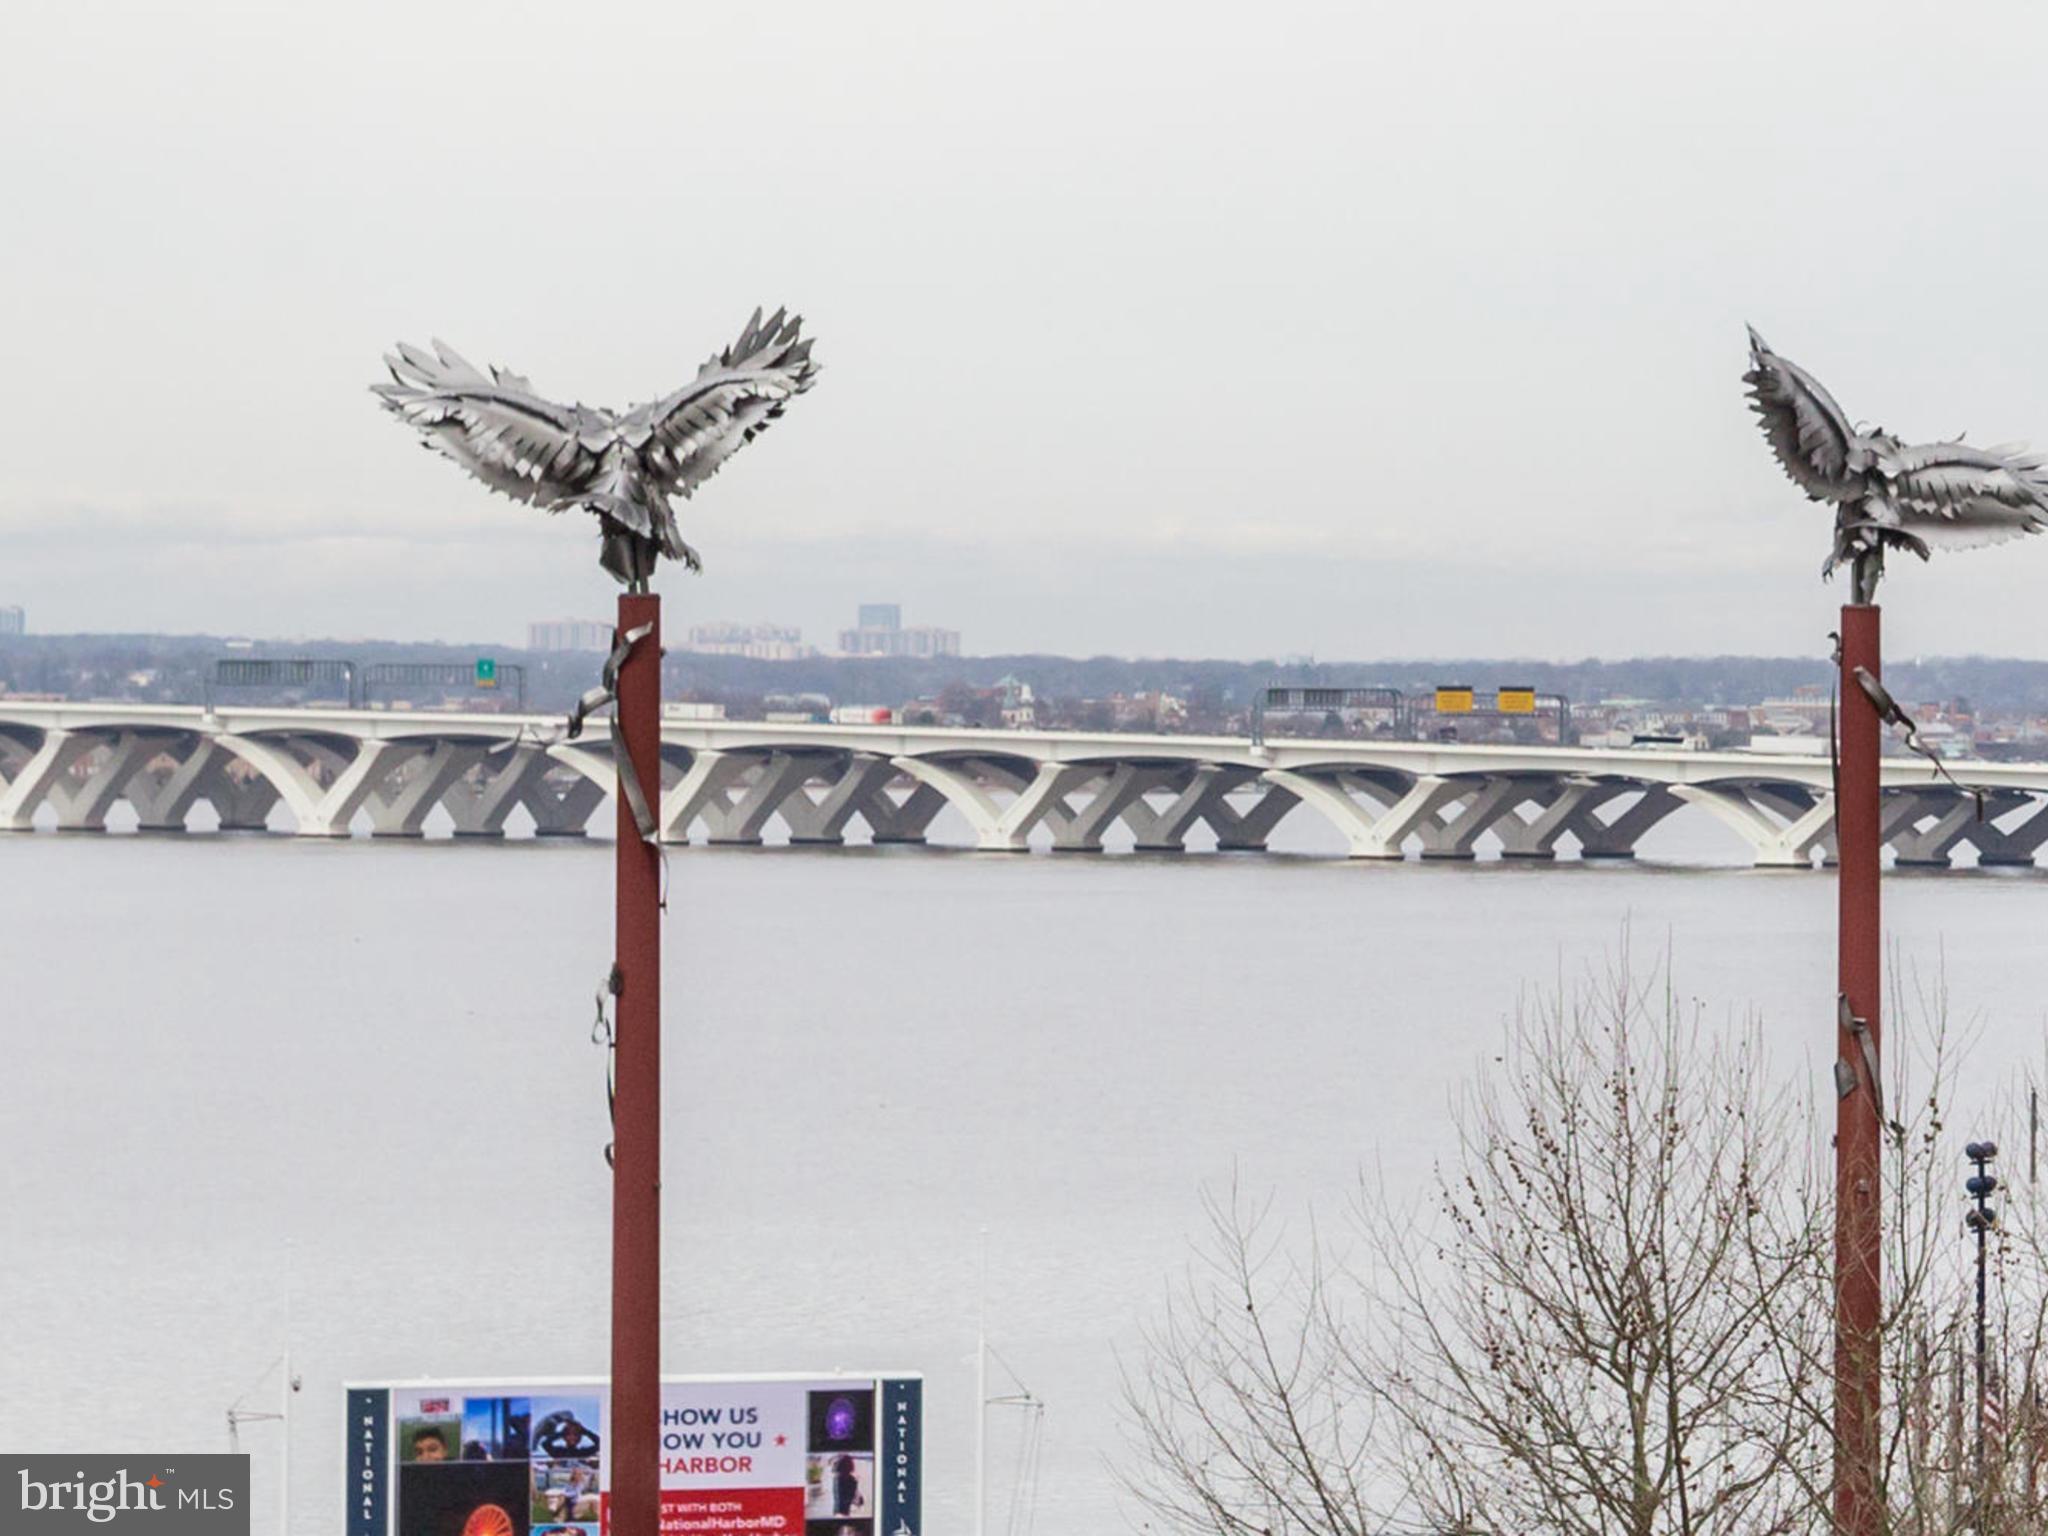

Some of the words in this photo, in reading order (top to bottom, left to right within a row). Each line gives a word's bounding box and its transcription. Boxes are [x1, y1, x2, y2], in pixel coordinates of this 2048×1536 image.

[663, 1408, 722, 1426] HOW
[729, 1407, 759, 1425] US
[712, 1431, 762, 1449] YOU
[896, 1402, 908, 1504] NATIONAL
[363, 1415, 374, 1520] NATIONAL
[659, 1456, 752, 1474] HARBOR
[677, 1502, 707, 1513] WITH
[709, 1502, 743, 1513] BOTH
